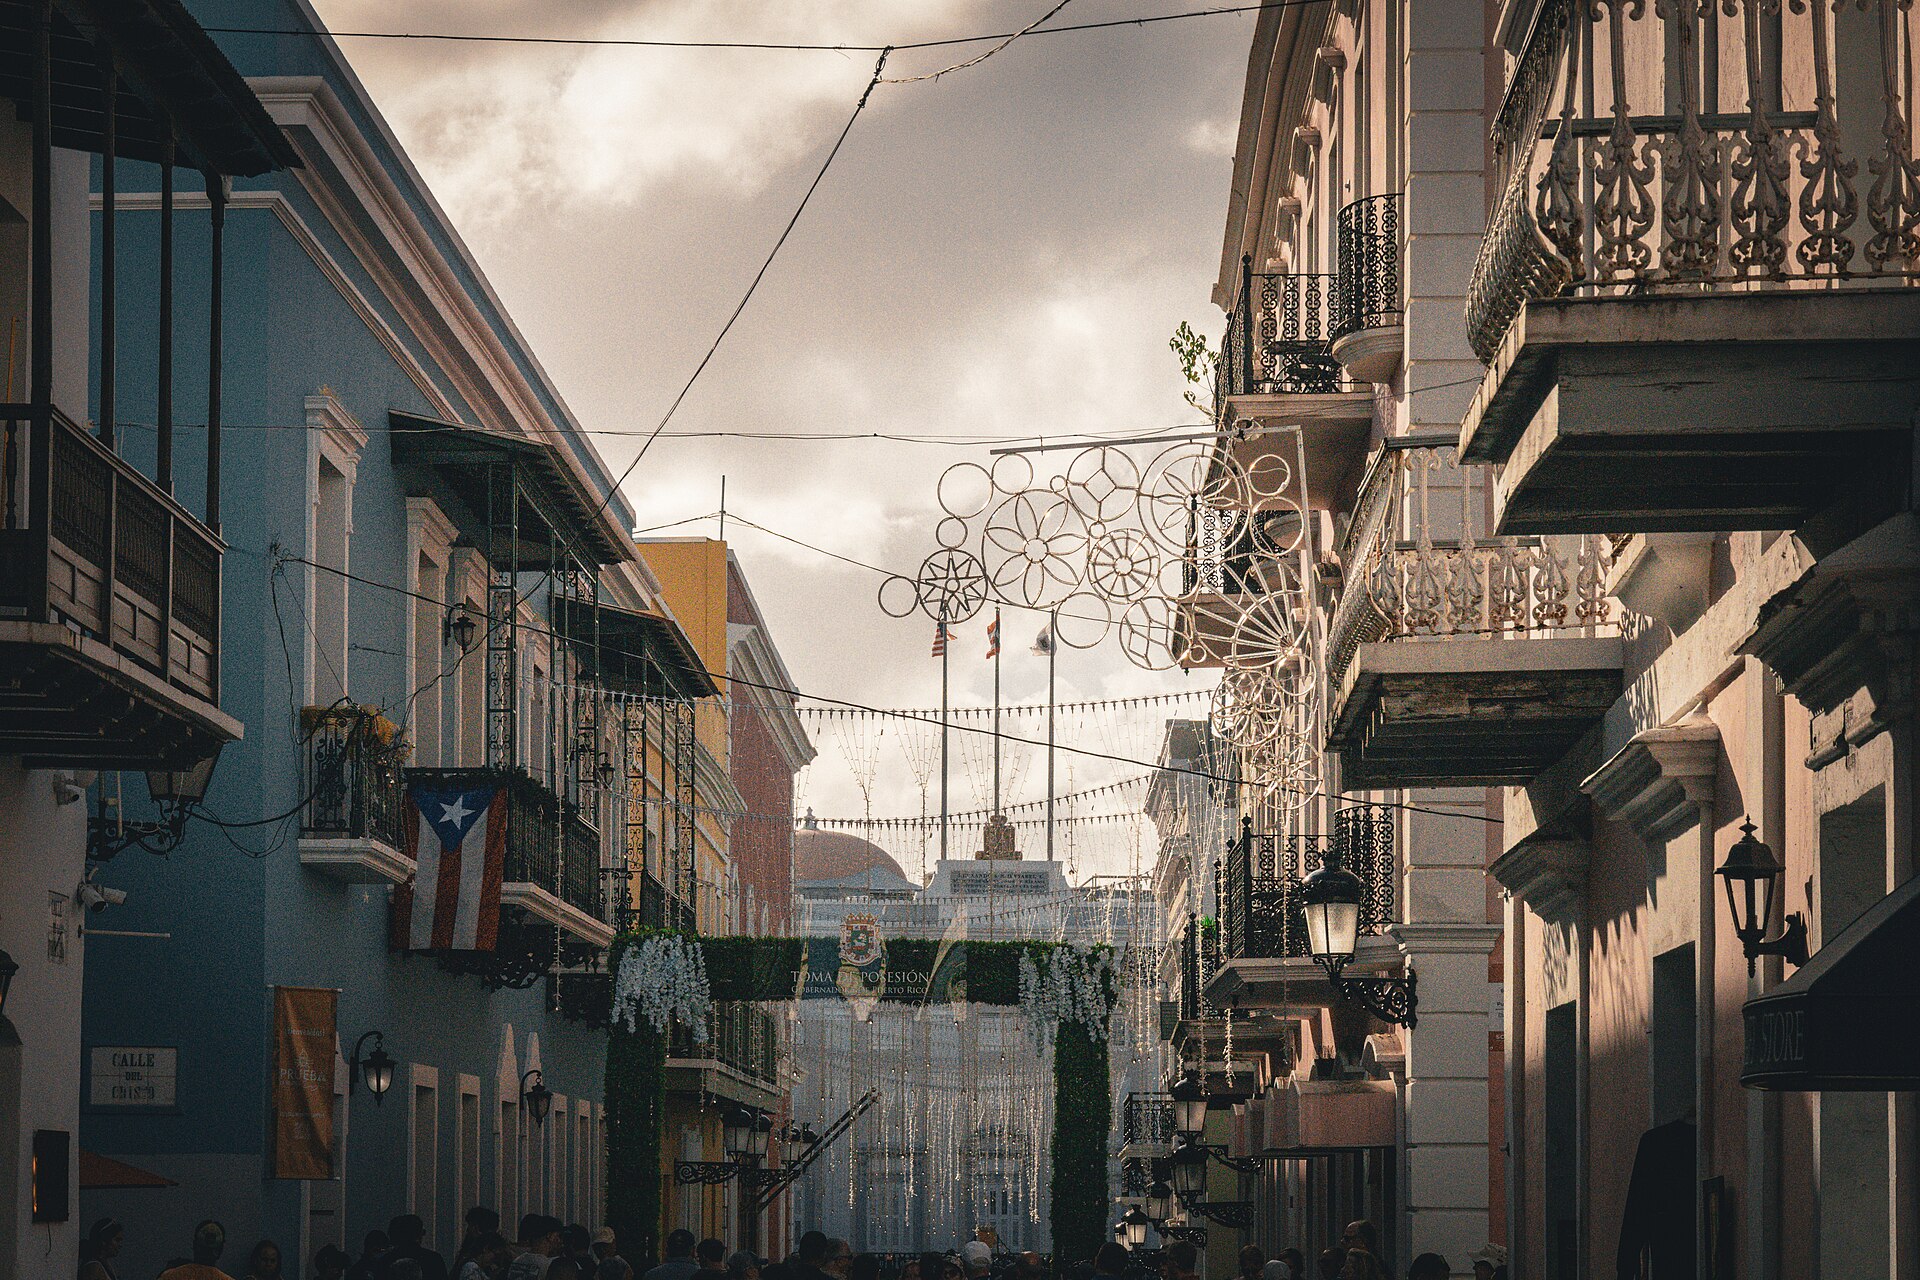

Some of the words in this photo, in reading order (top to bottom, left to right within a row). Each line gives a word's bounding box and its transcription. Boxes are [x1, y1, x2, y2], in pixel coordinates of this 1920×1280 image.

[790, 970, 833, 983] TOMA
[861, 968, 931, 983] POSESIÓN
[906, 985, 928, 994] RICO
[1759, 1009, 1805, 1063] STORE
[112, 1053, 155, 1067] CALLE
[125, 1071, 142, 1081] DEL
